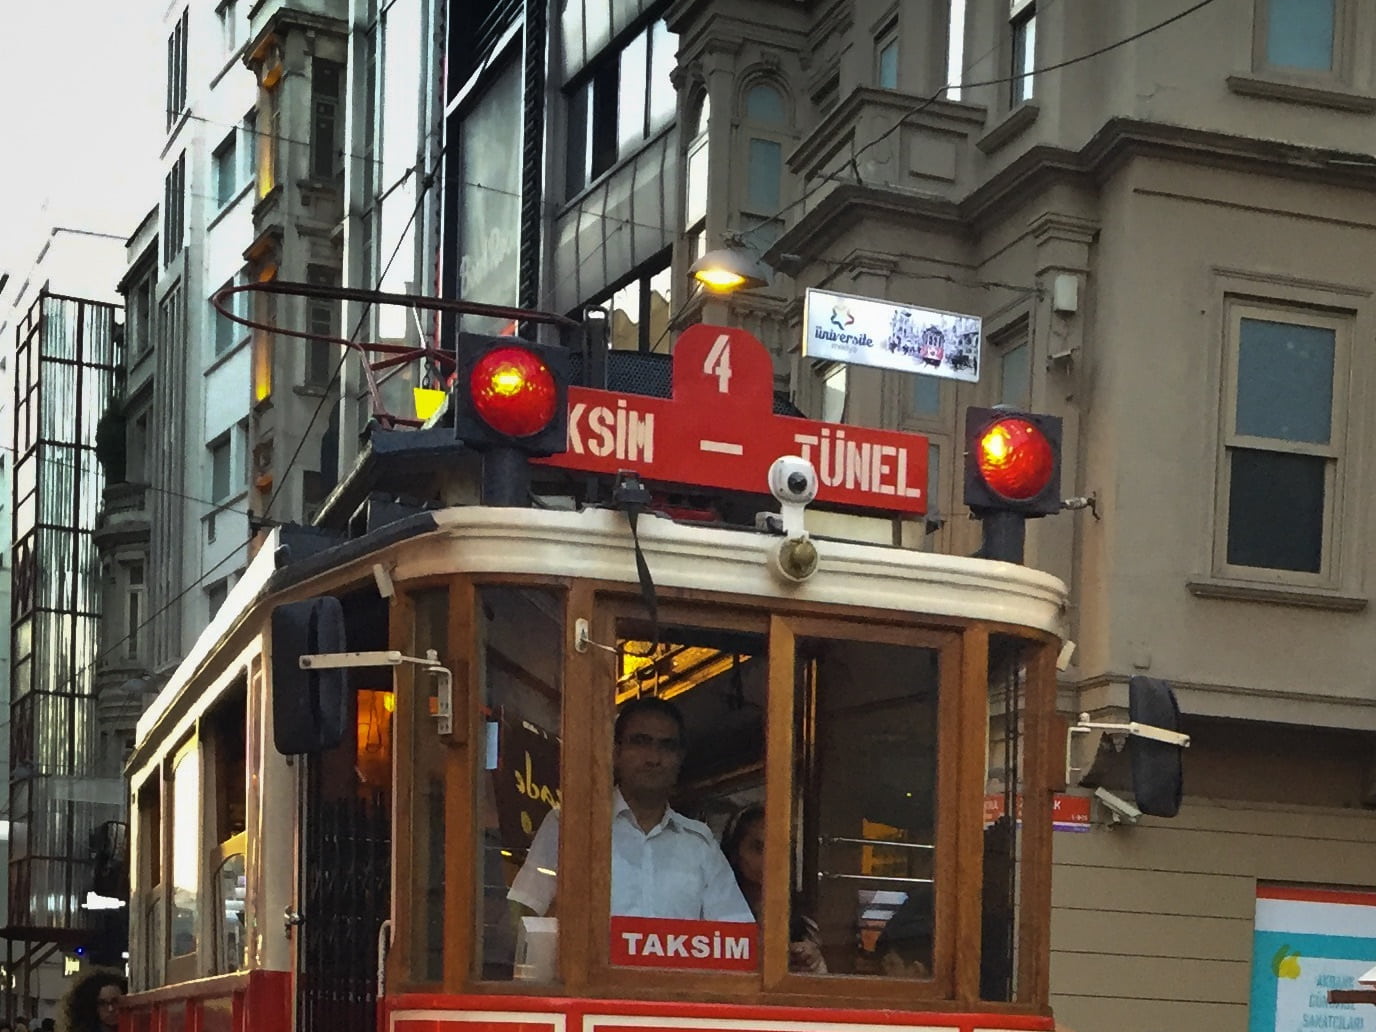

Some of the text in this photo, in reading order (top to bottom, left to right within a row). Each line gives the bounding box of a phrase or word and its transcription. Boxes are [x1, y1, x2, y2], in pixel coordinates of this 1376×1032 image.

[815, 326, 874, 348] üniversite
[703, 334, 732, 394] 4
[568, 400, 655, 463] KSİM
[794, 428, 921, 498] TÜNEL
[621, 930, 750, 960] TAKSİM
